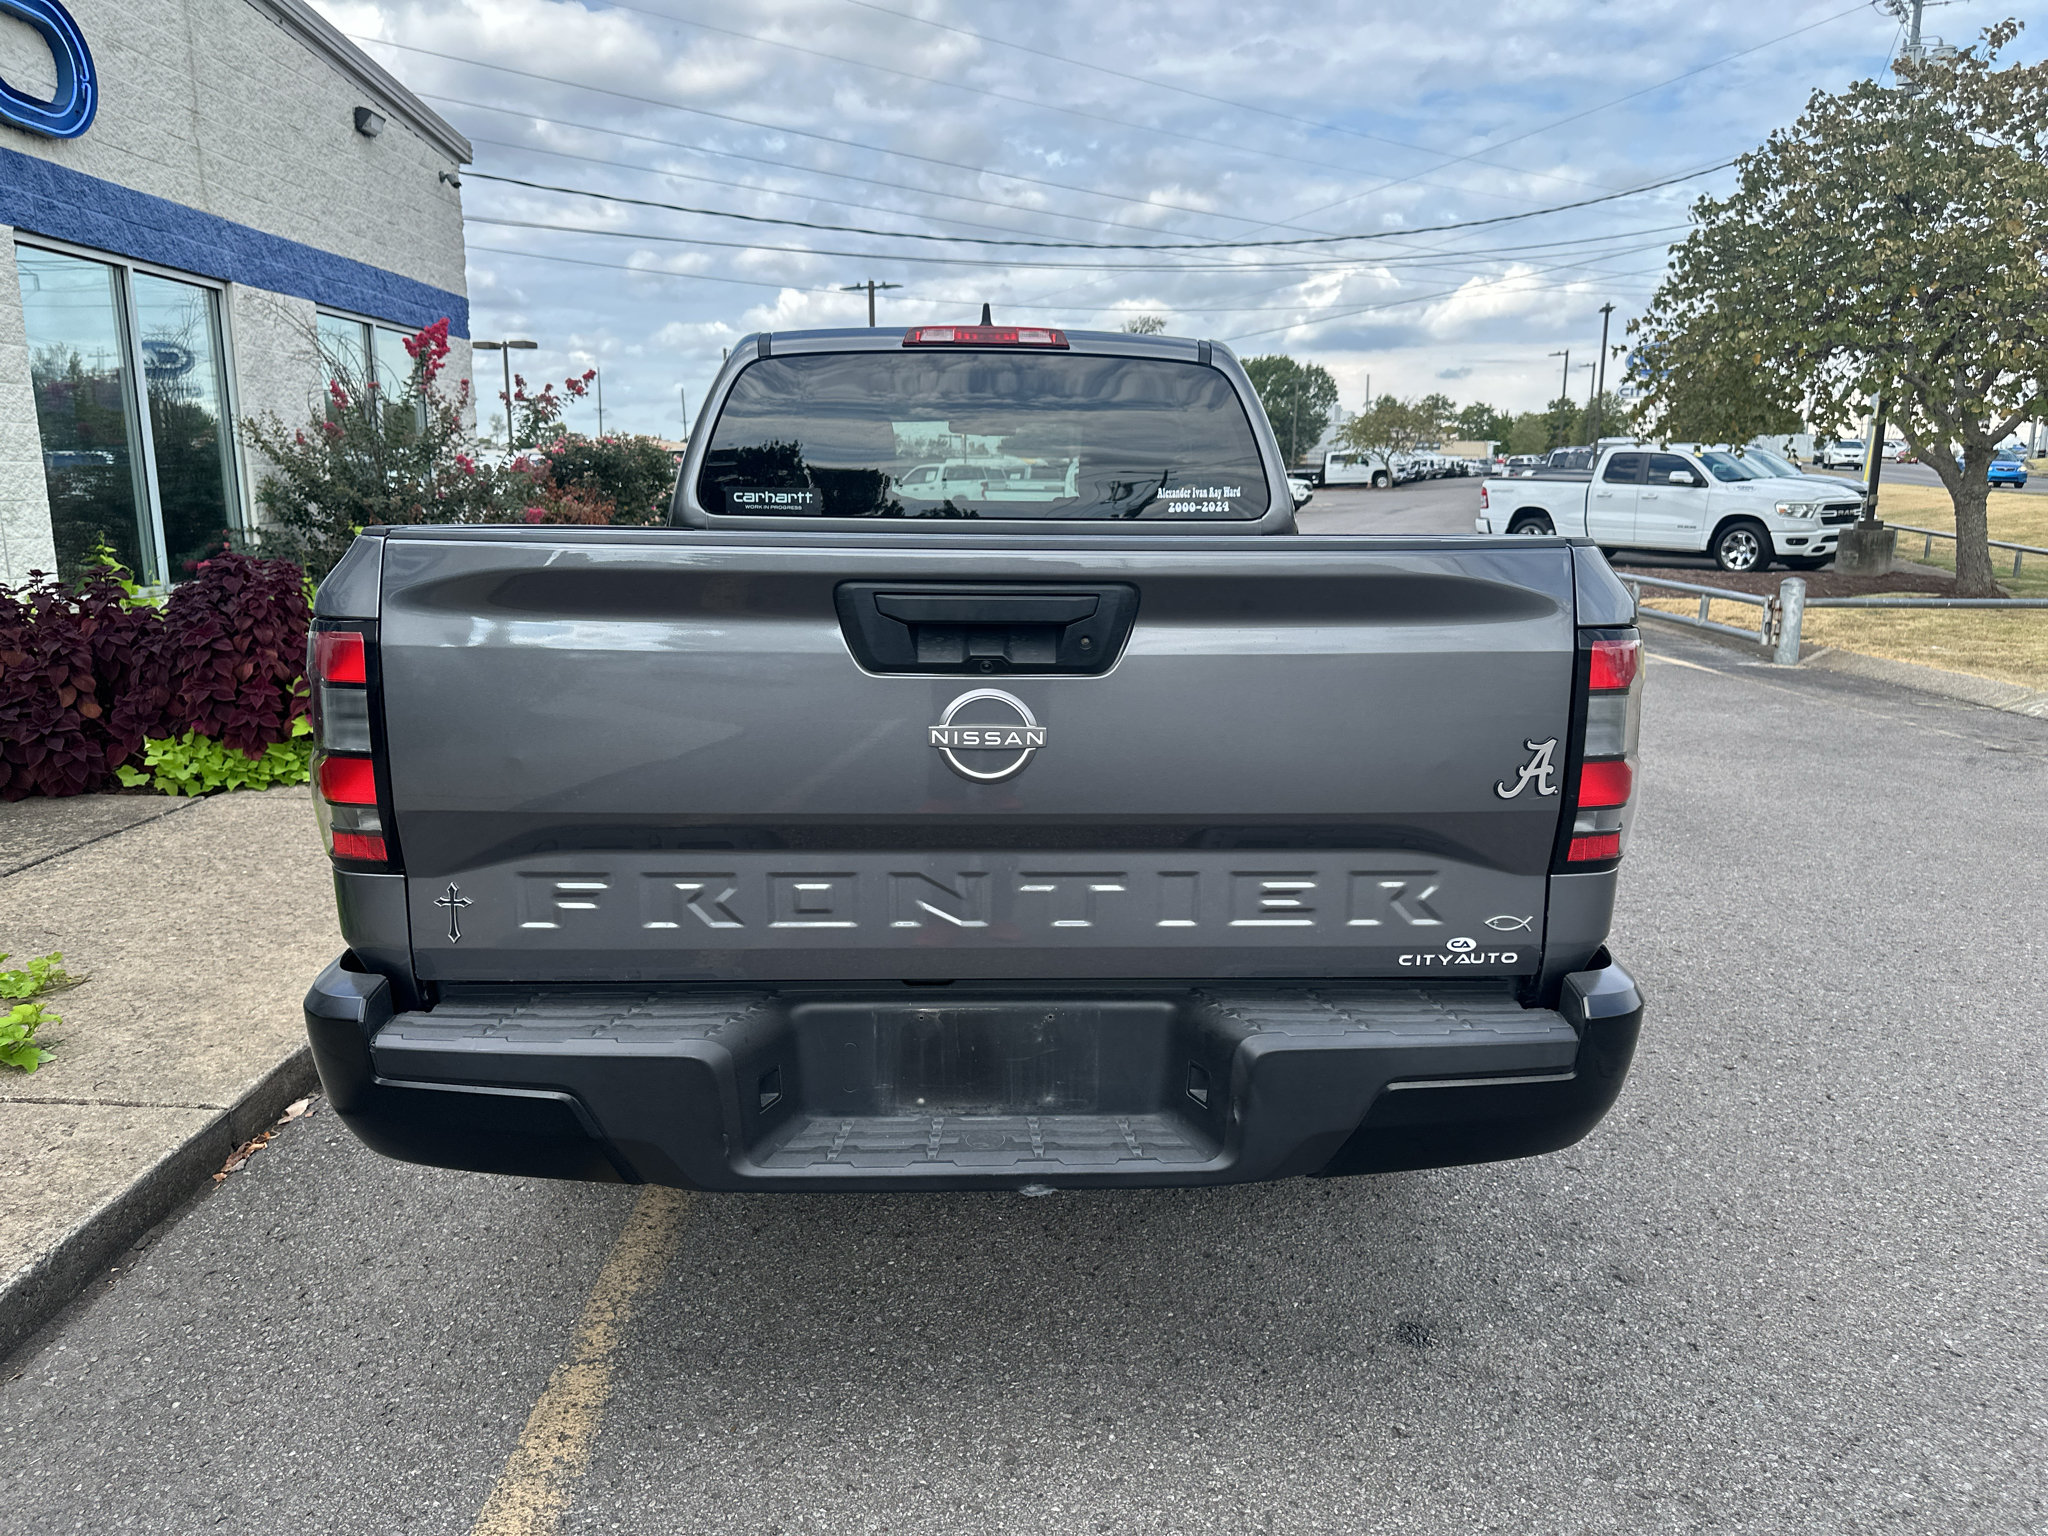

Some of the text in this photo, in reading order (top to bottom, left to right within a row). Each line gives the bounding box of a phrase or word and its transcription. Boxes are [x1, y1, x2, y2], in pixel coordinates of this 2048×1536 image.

[1157, 487, 1191, 499] Alexander
[1192, 486, 1208, 499] Ivan
[1209, 486, 1222, 500] Ray
[1168, 501, 1229, 513] 2000-2024
[931, 730, 1044, 745] NISSAN
[1494, 736, 1558, 800] A
[516, 870, 1444, 929] FRONTIER
[1450, 940, 1471, 949] CA
